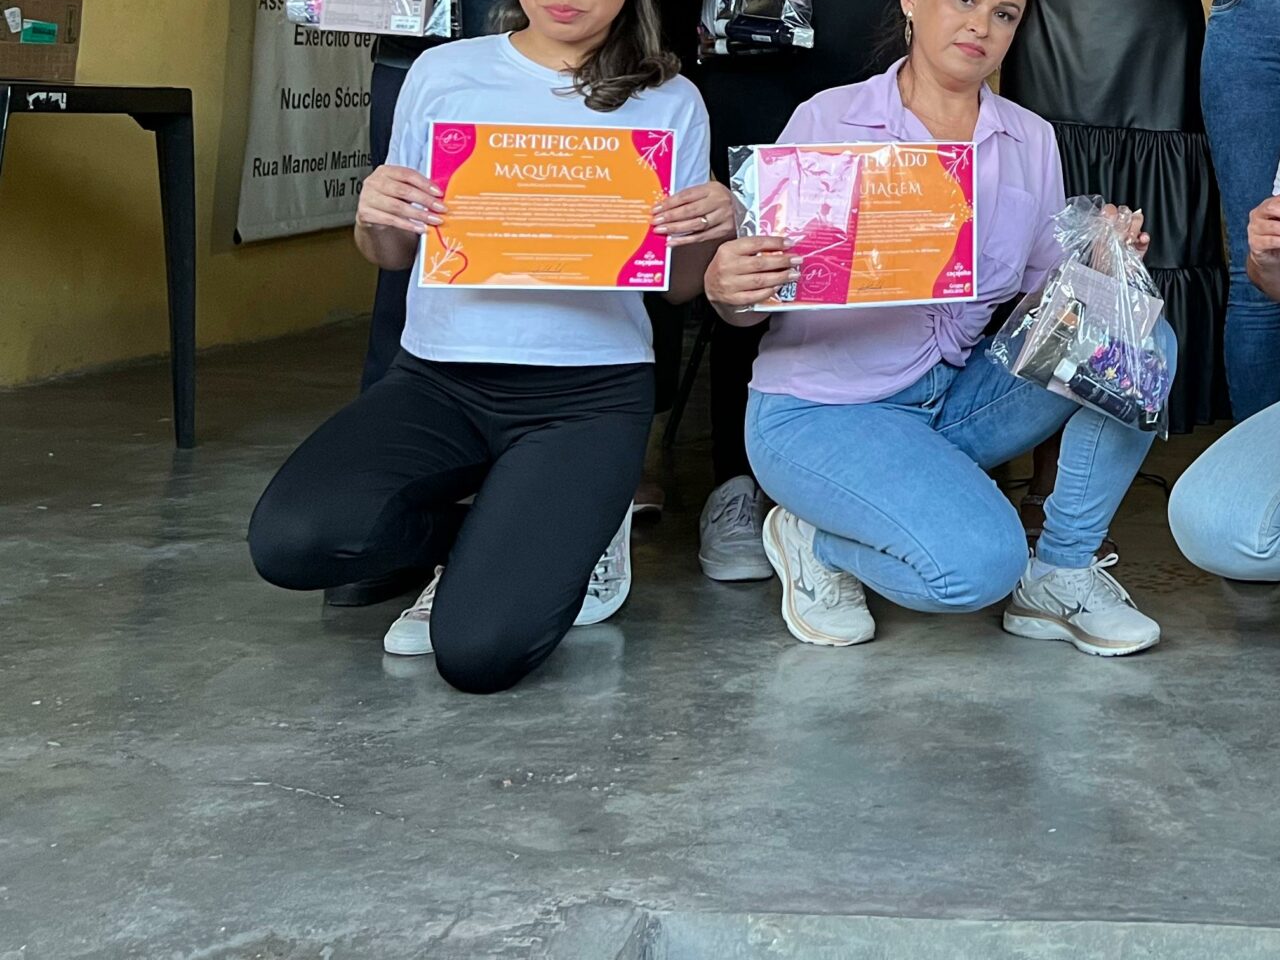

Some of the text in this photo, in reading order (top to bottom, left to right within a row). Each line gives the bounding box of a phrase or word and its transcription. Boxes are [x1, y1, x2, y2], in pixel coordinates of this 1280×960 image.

[280, 87, 331, 110] Nucleo
[489, 132, 620, 152] CERTIFICADO
[252, 149, 373, 178] Rua Manoel Martins
[494, 161, 613, 182] MAQUIAGEM
[323, 178, 346, 199] Vila
